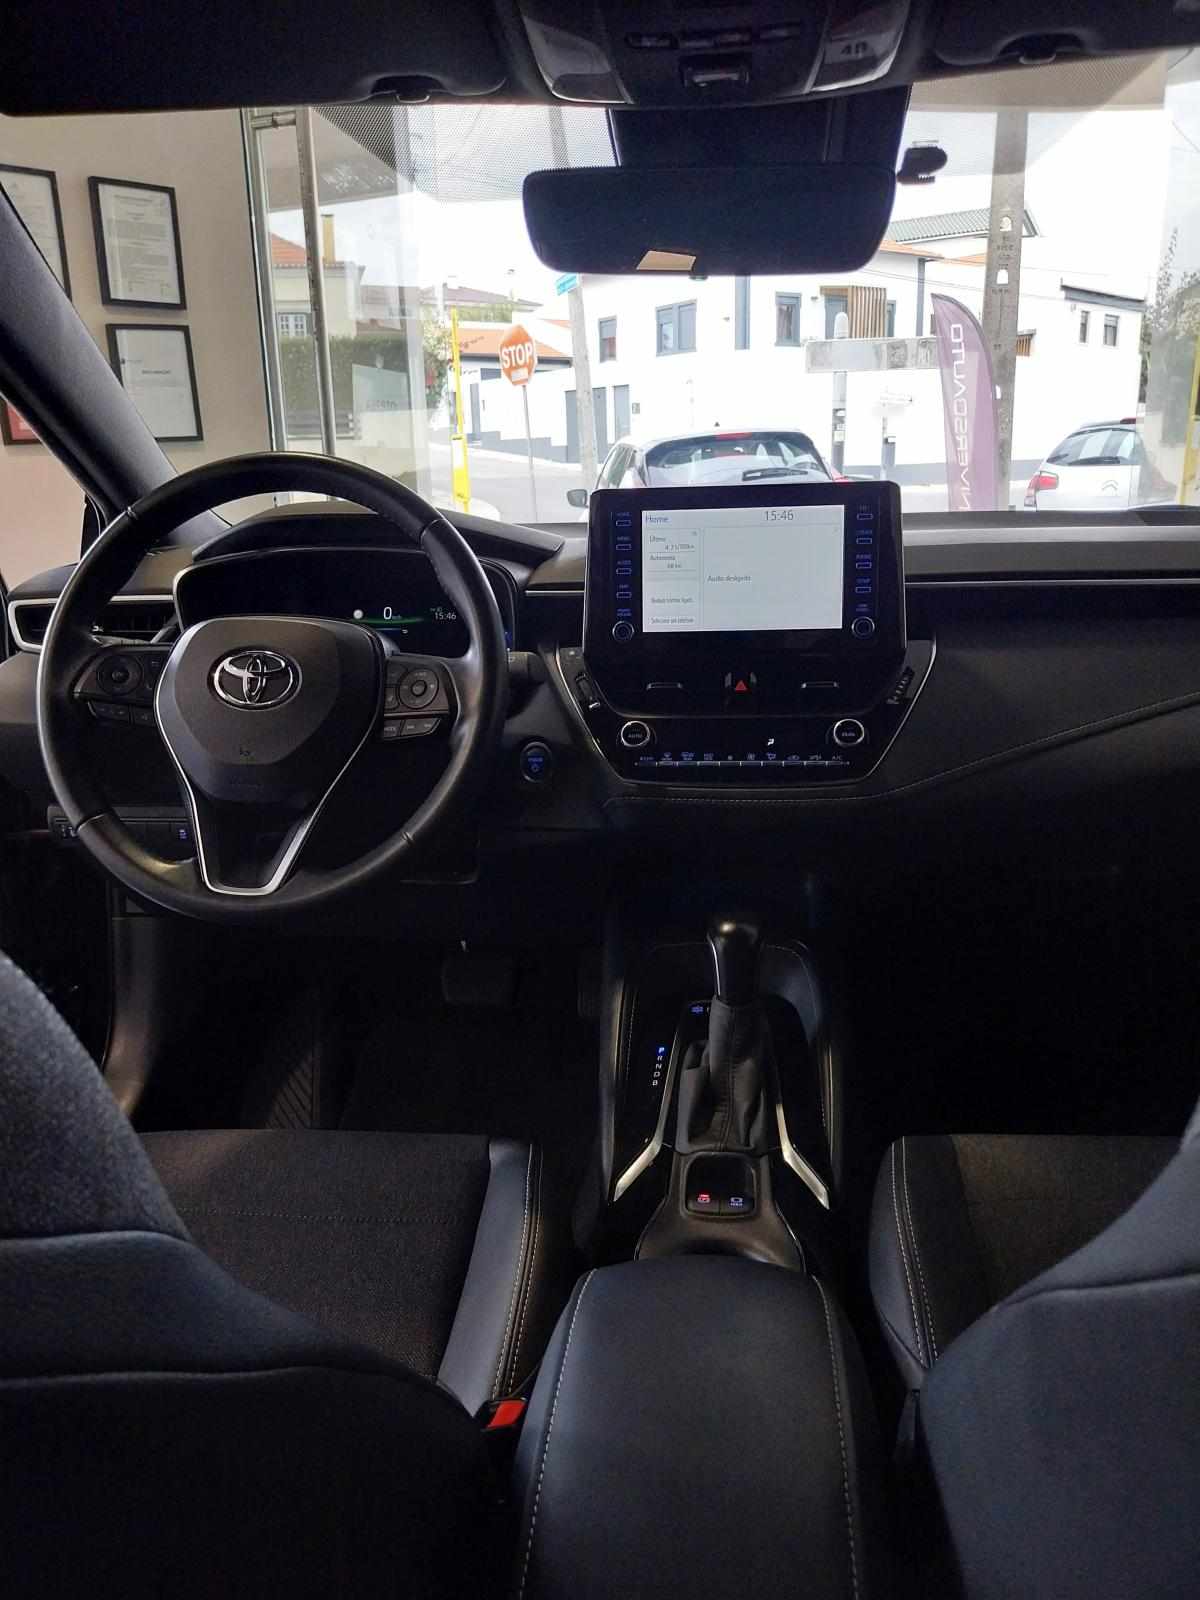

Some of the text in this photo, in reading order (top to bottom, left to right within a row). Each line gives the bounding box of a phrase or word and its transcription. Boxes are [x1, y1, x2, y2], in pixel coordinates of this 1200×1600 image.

[502, 343, 533, 368] STOP
[646, 514, 669, 524] Home
[764, 509, 794, 521] 15:46
[383, 606, 393, 620] 0
[434, 611, 457, 621] 15:46
